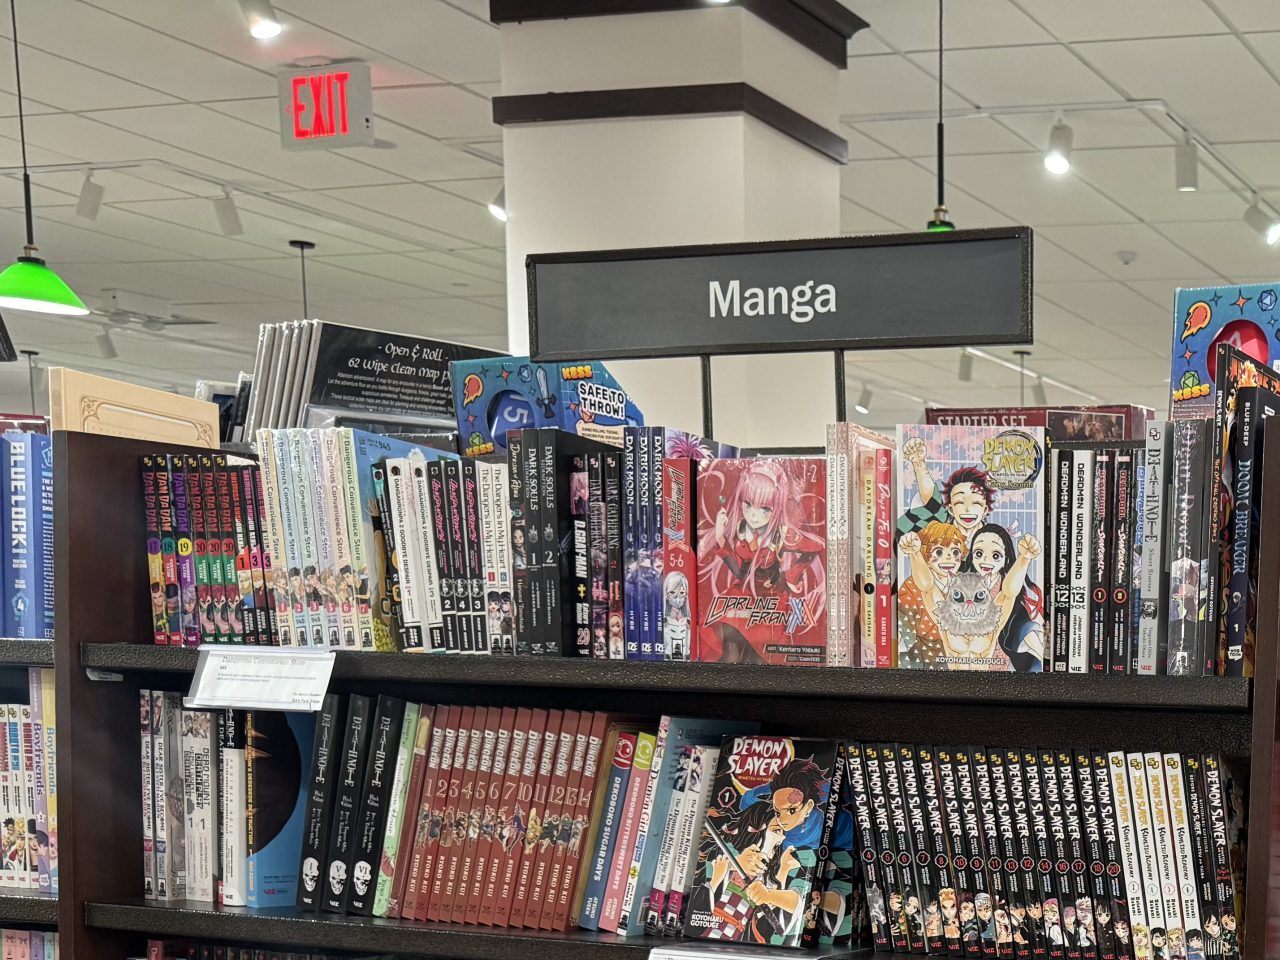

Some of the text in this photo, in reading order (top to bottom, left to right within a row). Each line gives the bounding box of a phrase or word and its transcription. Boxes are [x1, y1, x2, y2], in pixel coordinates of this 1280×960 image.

[291, 71, 350, 139] EXIT
[709, 280, 837, 321] Manga
[348, 358, 359, 368] 62
[562, 366, 592, 379] KESS
[579, 382, 624, 404] SAFE TO
[582, 397, 624, 418] THROW!
[937, 415, 1027, 427] STARTER SET
[984, 438, 1035, 455] DEMON
[983, 455, 1035, 473] SLAYER
[529, 448, 538, 511] DARK SOULS
[1075, 513, 1084, 580] WONDERLAND
[670, 555, 684, 567] 5-6
[577, 628, 590, 645] 29
[973, 657, 1006, 665] GOTOUGE
[733, 737, 785, 758] DEMON
[728, 756, 782, 777] SLAYER
[503, 782, 516, 800] 7
[724, 792, 729, 801] 1
[690, 920, 720, 929] GOTOUGE
[691, 914, 724, 923] KOYOHARU
